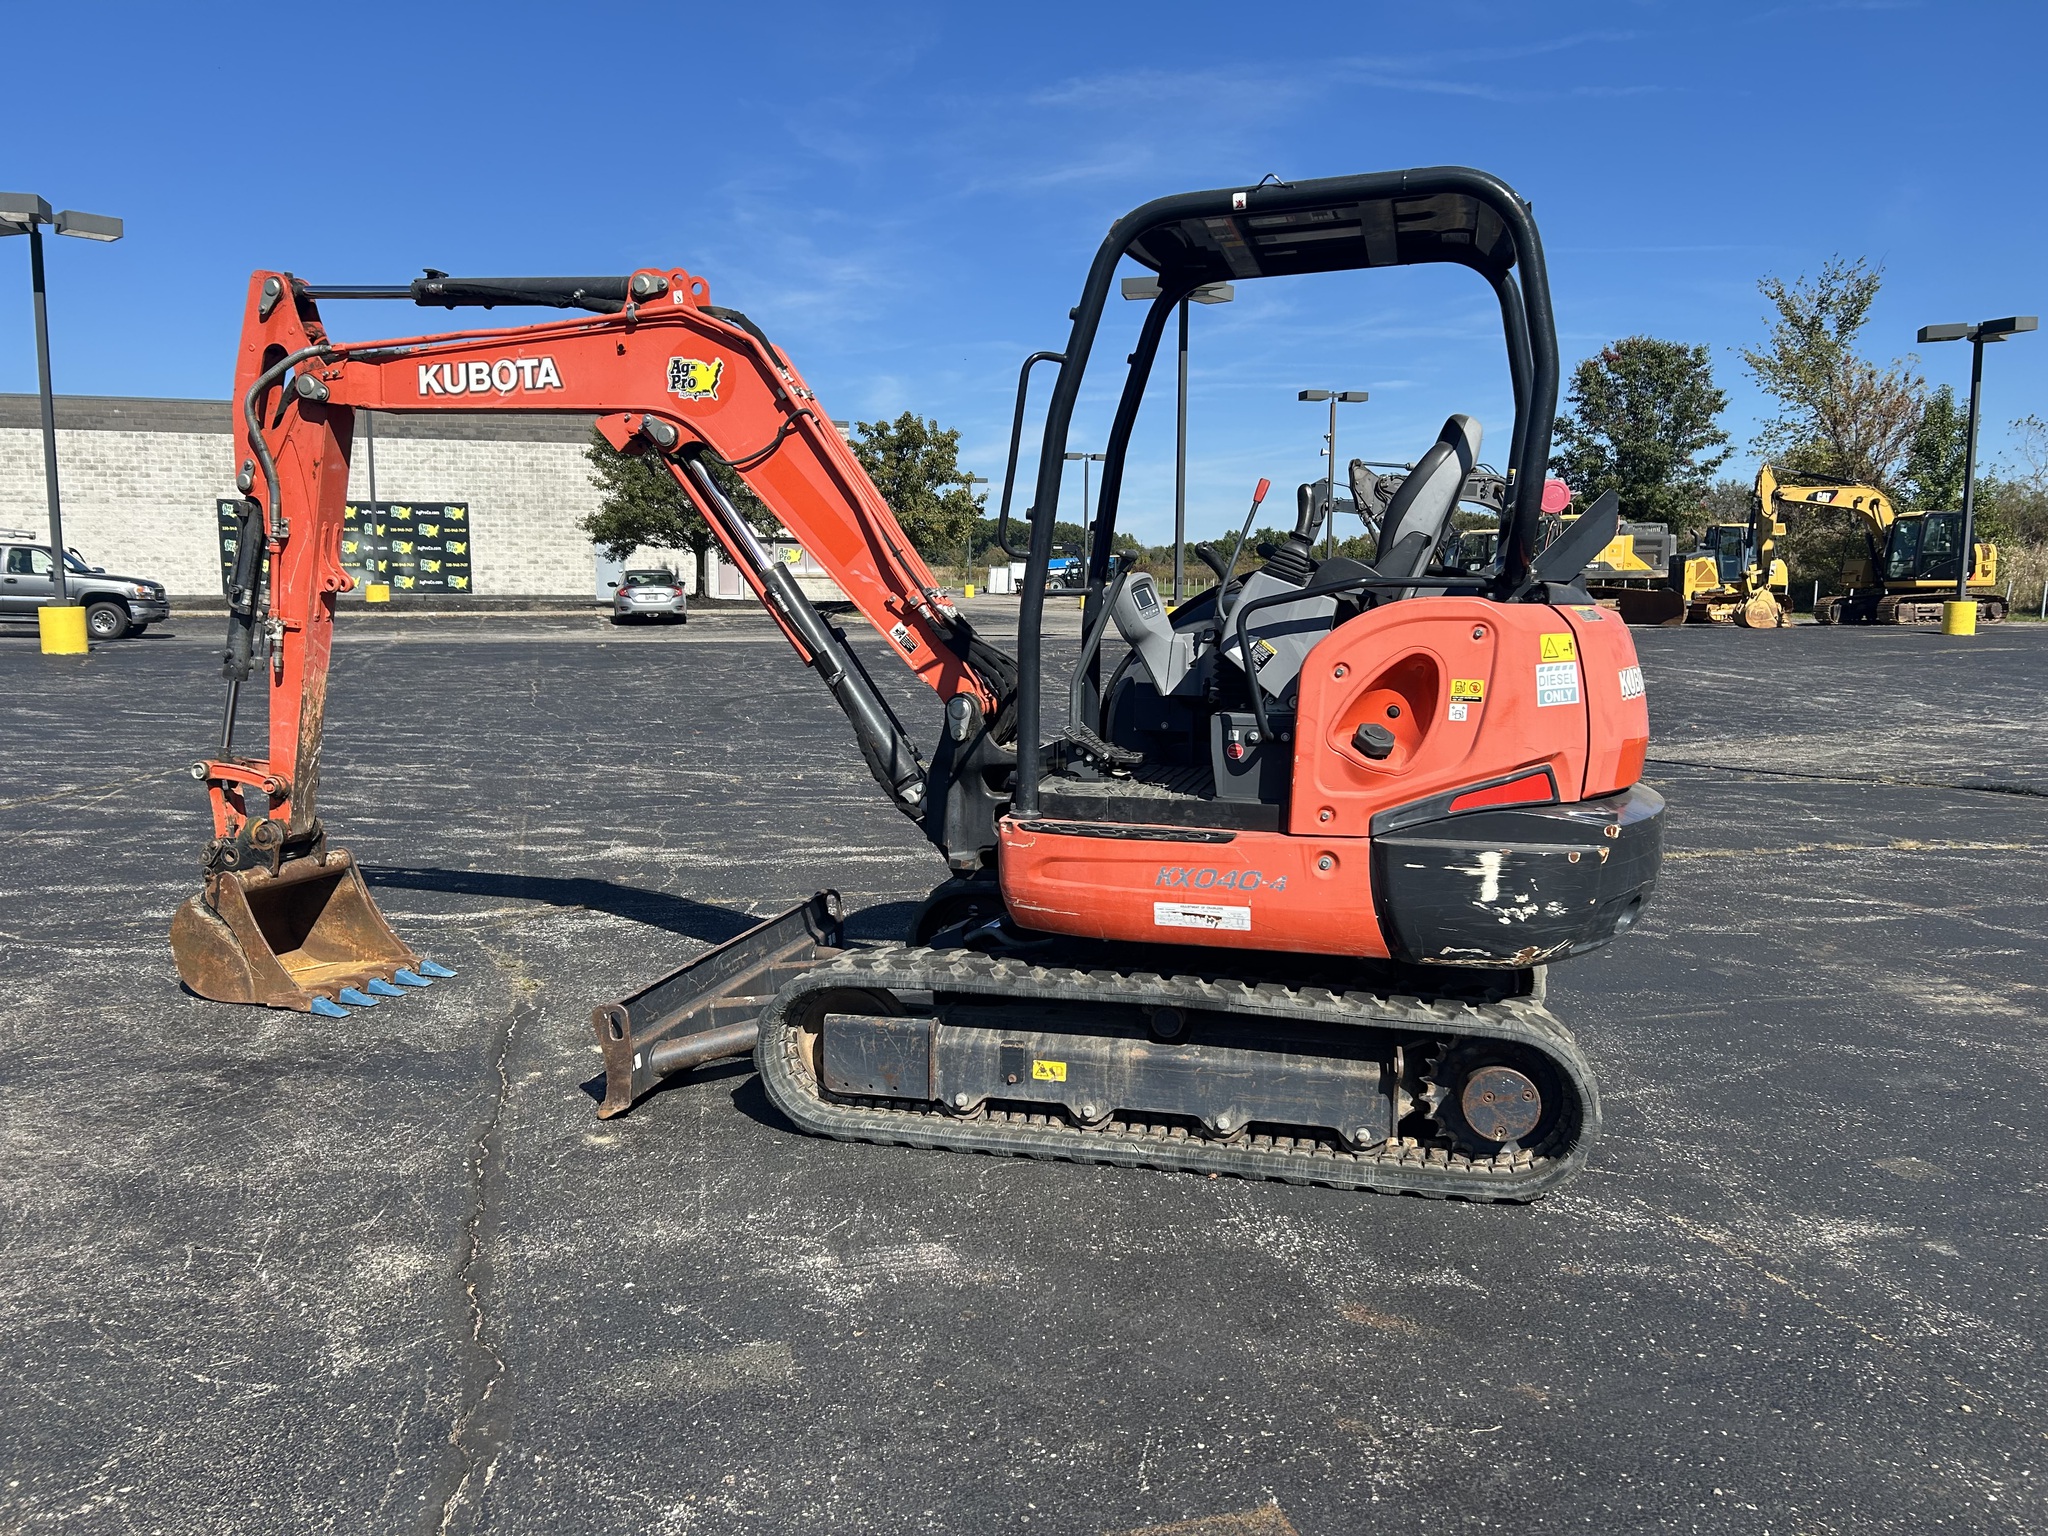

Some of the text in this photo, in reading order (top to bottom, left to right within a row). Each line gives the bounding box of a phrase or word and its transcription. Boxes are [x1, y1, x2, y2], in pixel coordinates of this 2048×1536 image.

[670, 358, 696, 376] Ag-
[418, 356, 562, 396] KUBOTA
[670, 375, 697, 390] Pro
[1816, 491, 1832, 503] CAT
[1538, 673, 1576, 688] DIESEL
[1618, 666, 1646, 698] KUB
[1543, 688, 1574, 704] ONLY
[1155, 866, 1288, 892] KX040-4
